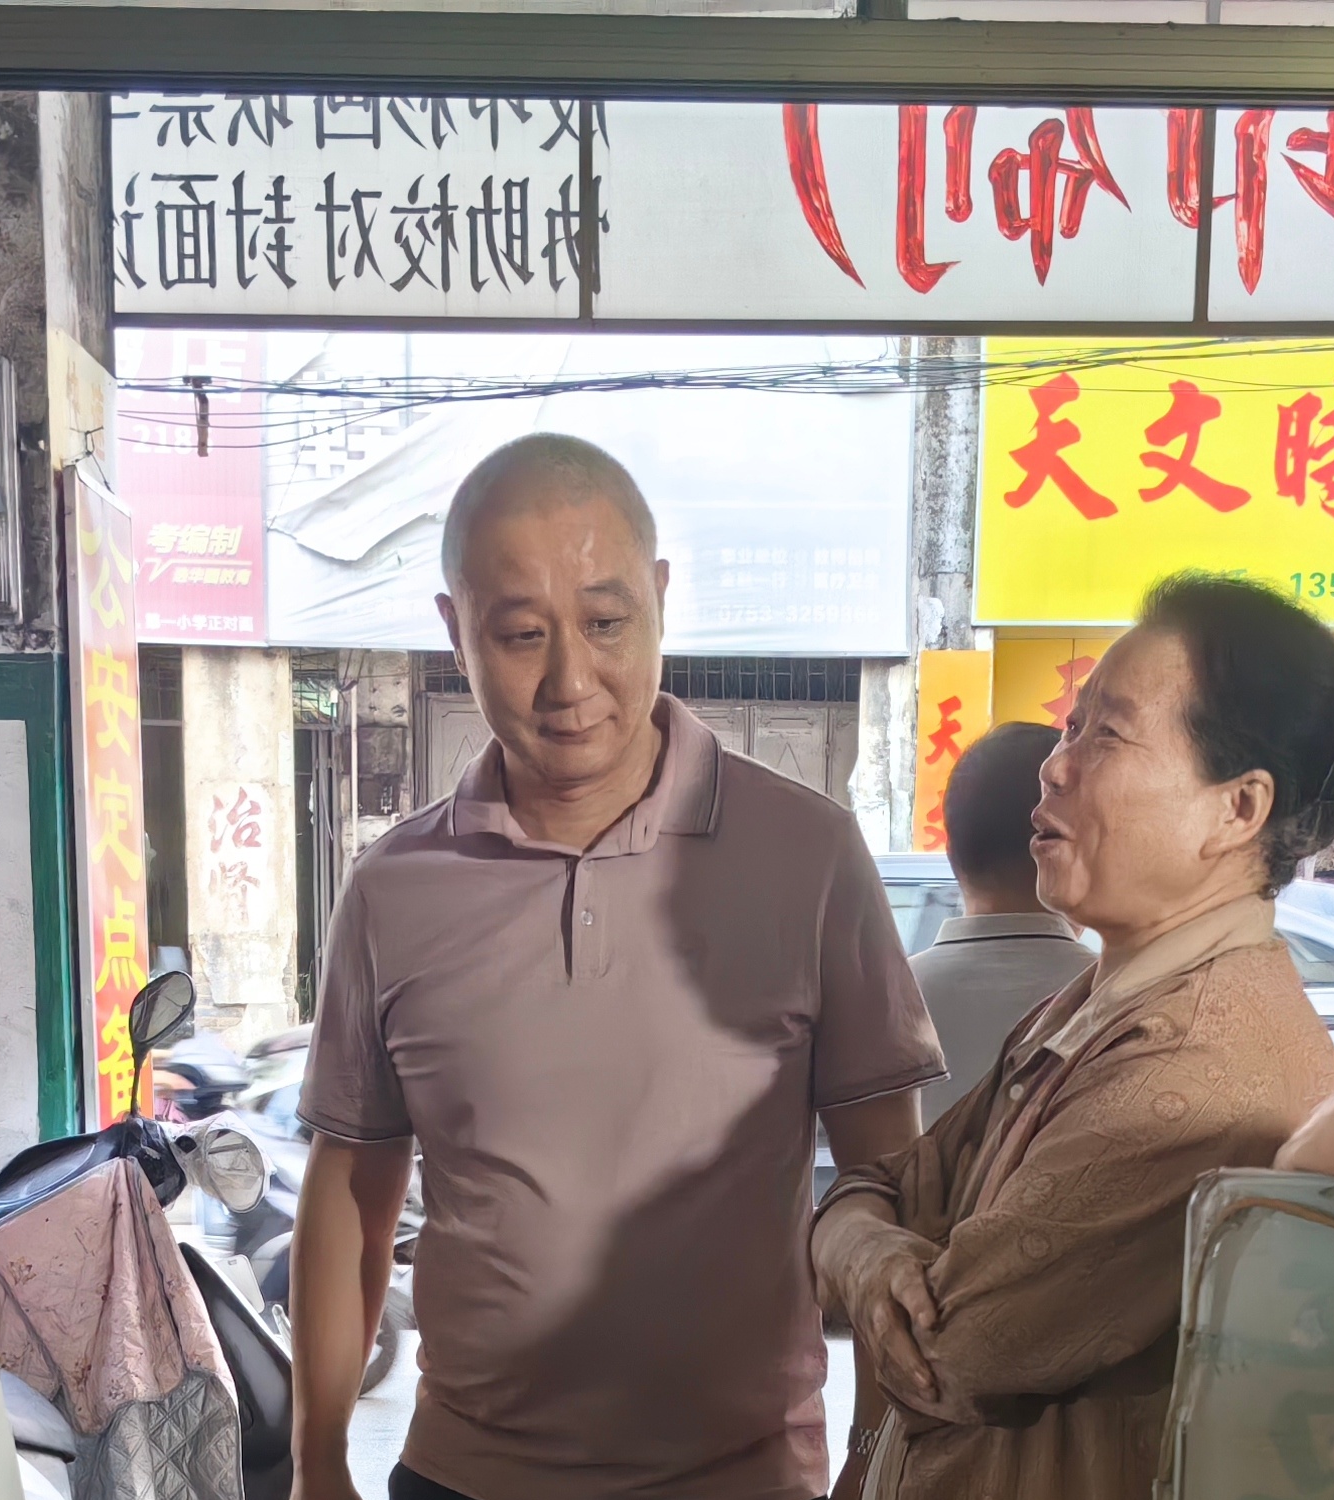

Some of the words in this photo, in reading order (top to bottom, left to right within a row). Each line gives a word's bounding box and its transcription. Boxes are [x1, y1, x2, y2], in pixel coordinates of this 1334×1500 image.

[131, 424, 214, 455] 218
[147, 523, 243, 557] 考编制
